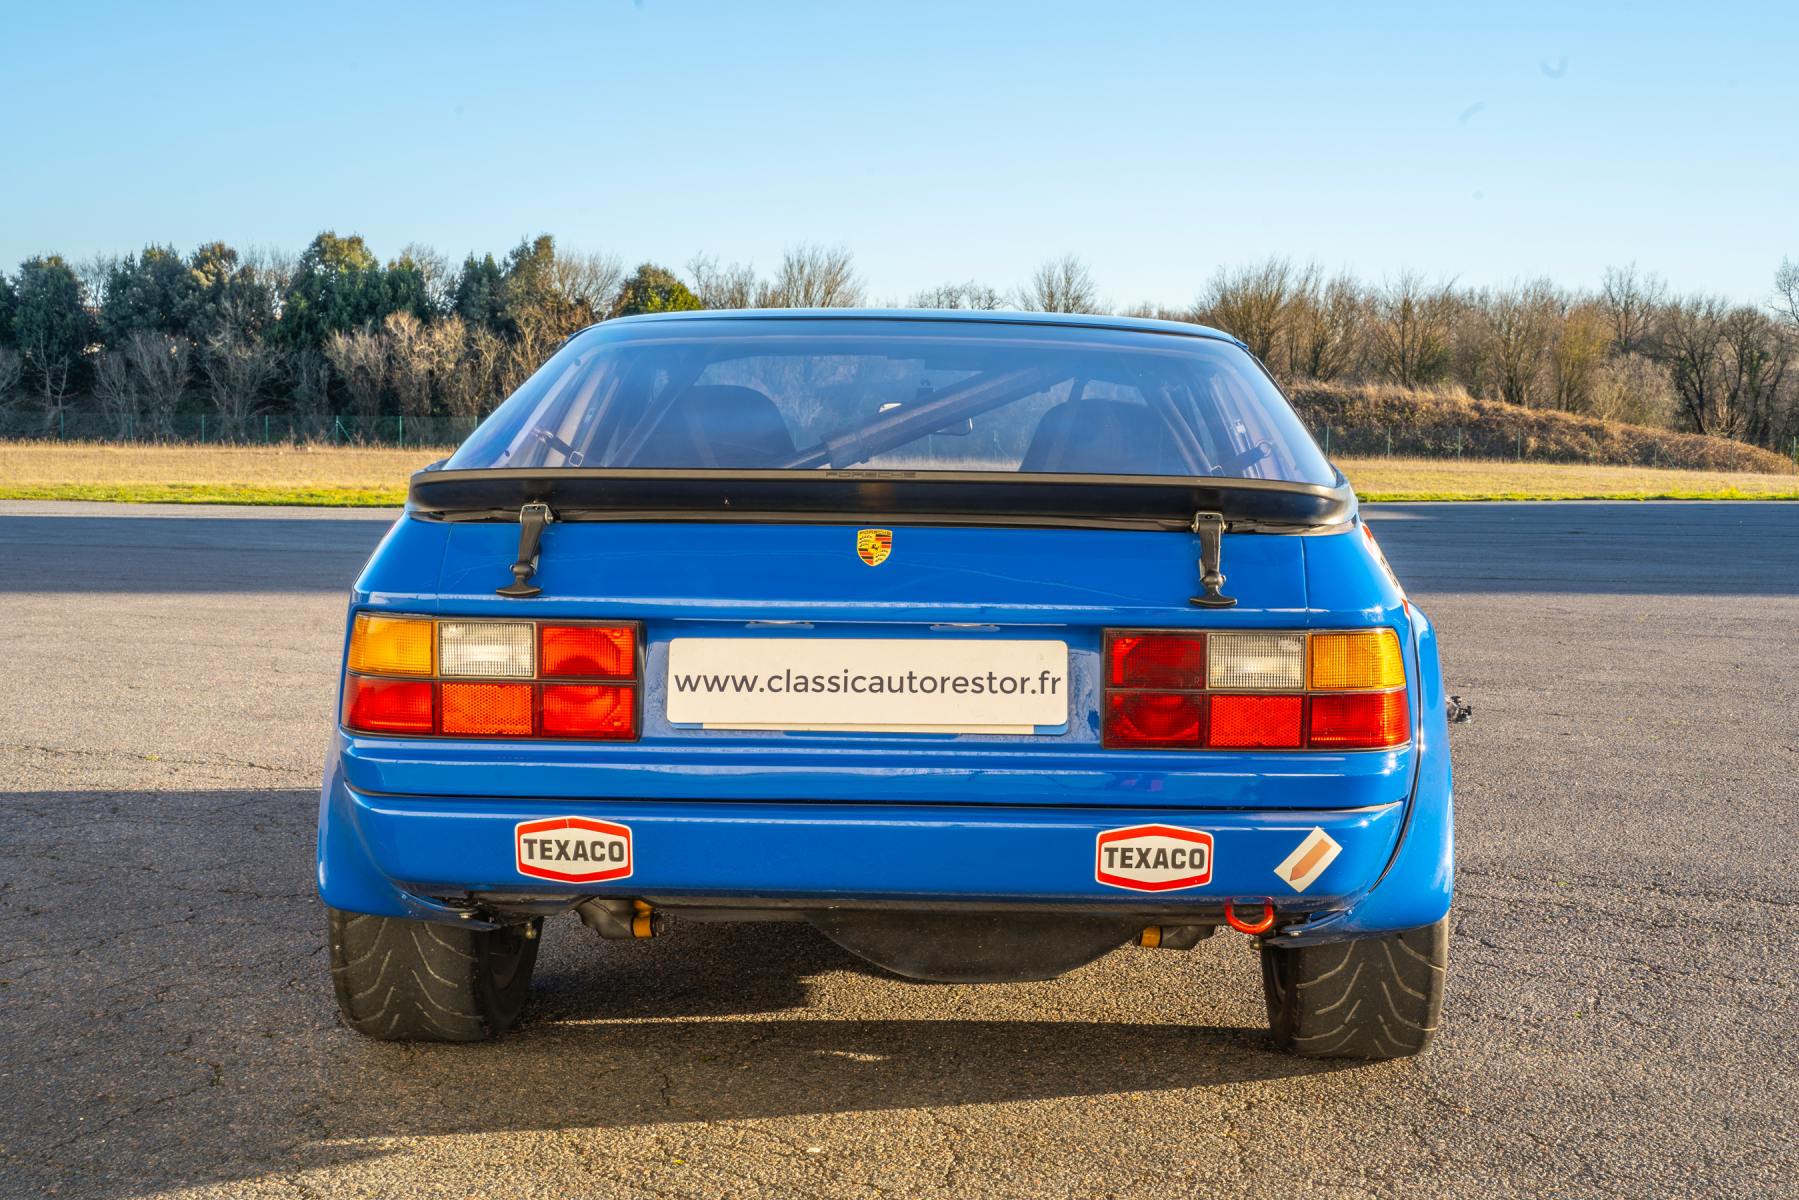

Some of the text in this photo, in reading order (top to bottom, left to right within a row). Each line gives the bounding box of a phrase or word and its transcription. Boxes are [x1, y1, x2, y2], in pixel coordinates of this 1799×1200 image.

[674, 669, 1062, 695] www.classicautorestor.fr
[523, 838, 625, 862] TEXACO
[1103, 847, 1205, 869] TEXACO
